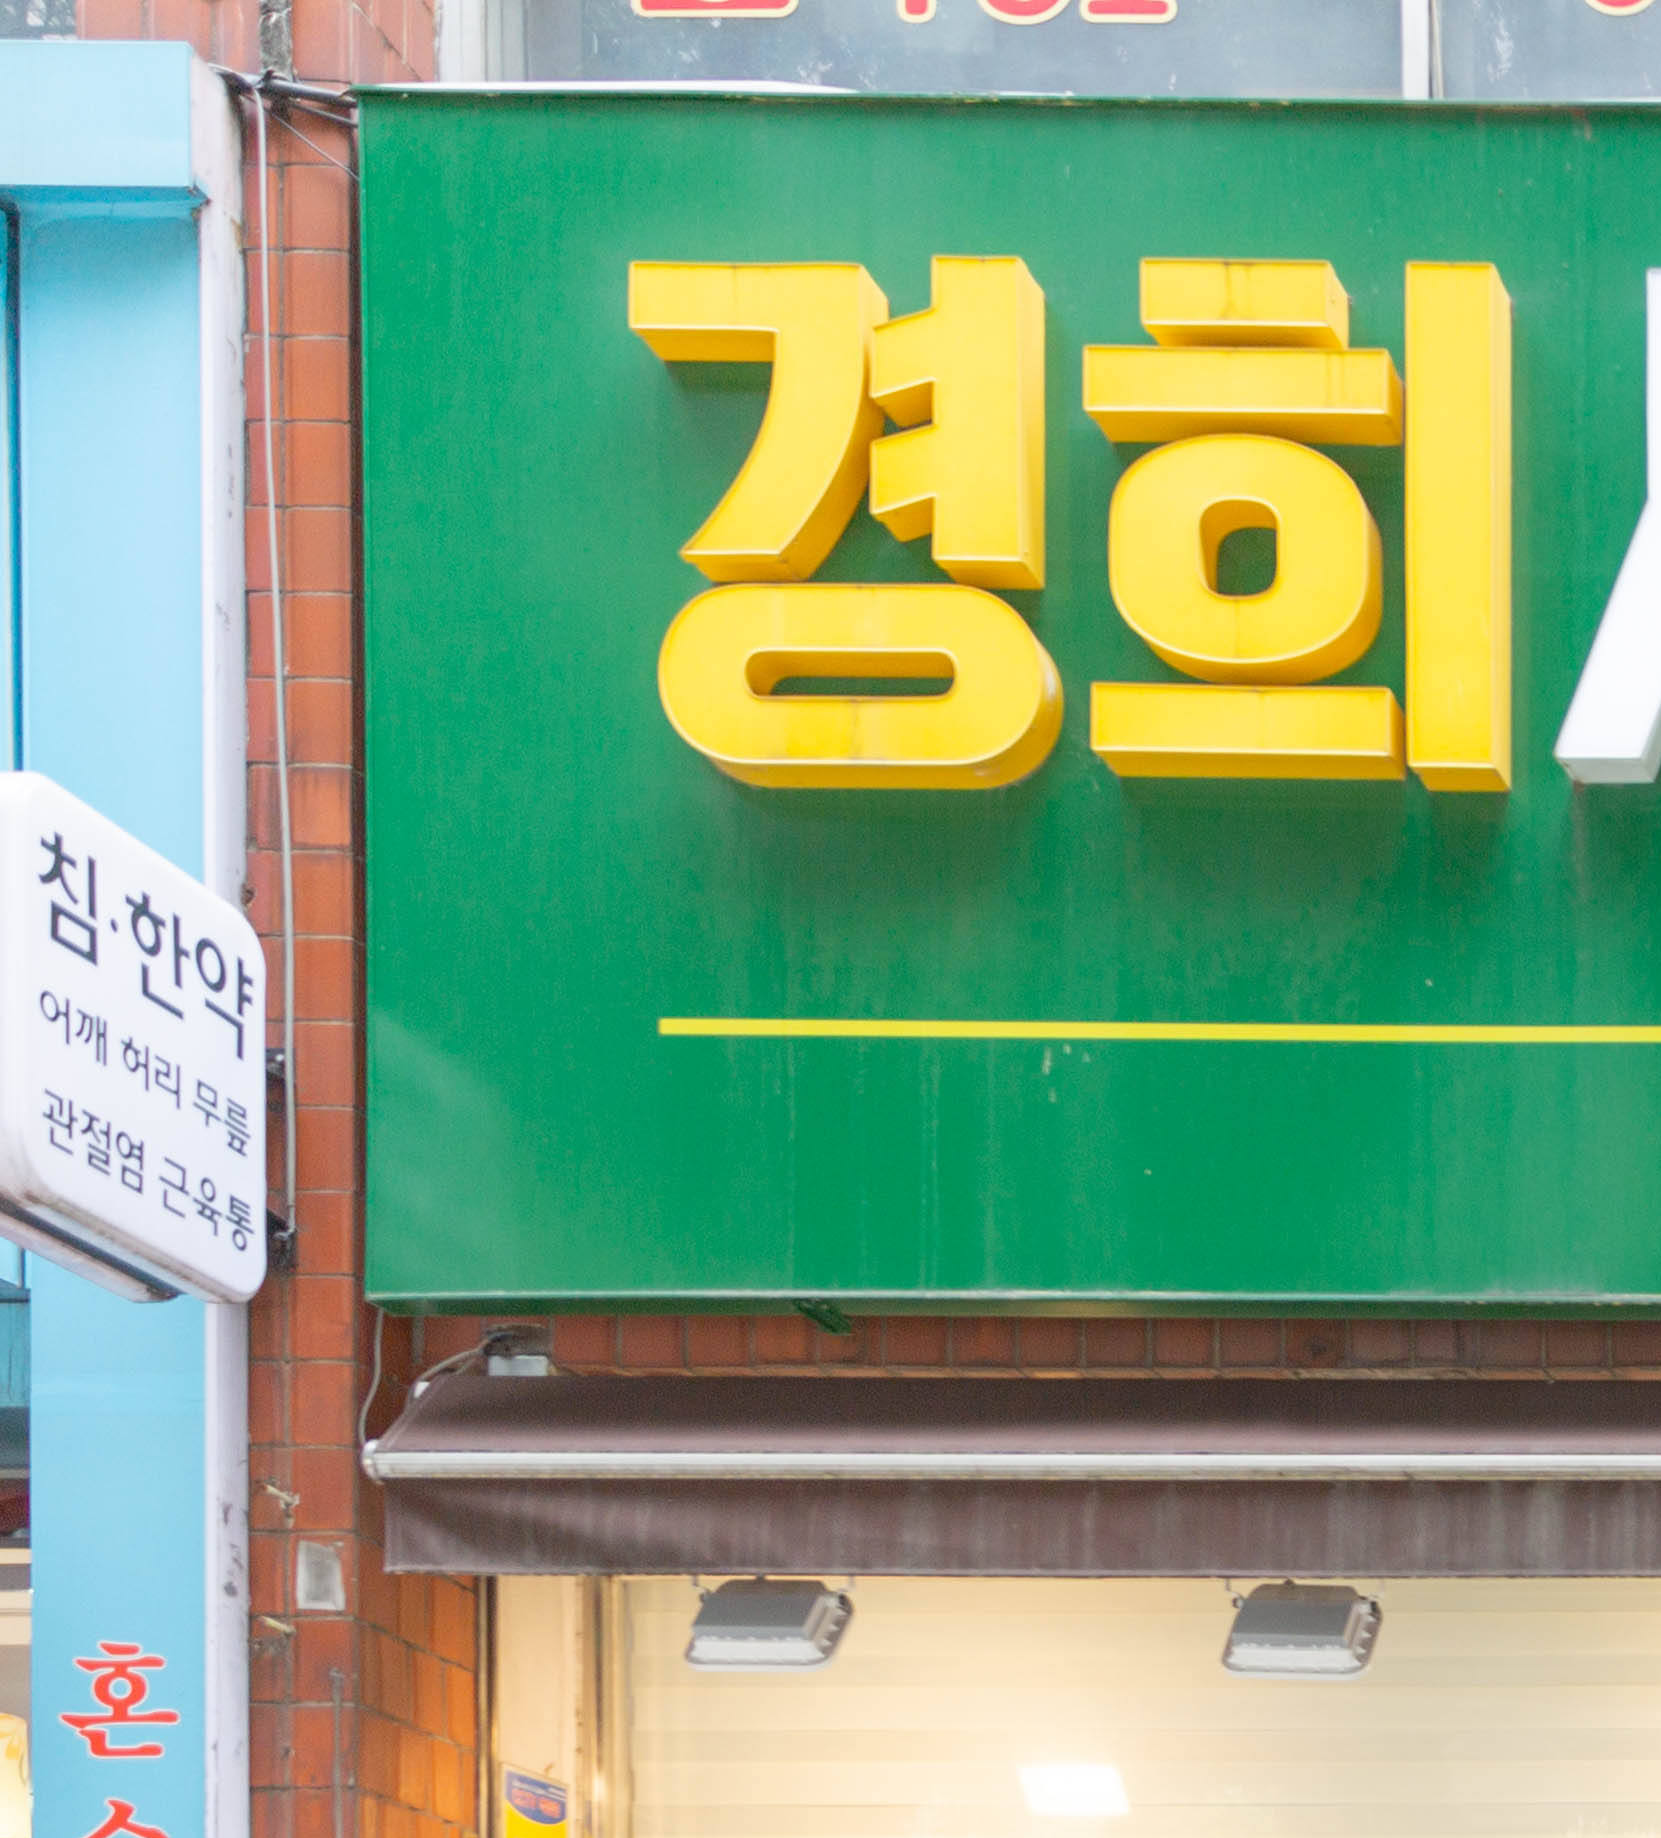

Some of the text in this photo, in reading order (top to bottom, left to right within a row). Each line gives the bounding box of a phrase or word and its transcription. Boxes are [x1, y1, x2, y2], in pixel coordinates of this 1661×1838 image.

[40, 990, 249, 1157] 어깨 허리 무릎
[41, 1087, 254, 1251] 관절염 근육통
